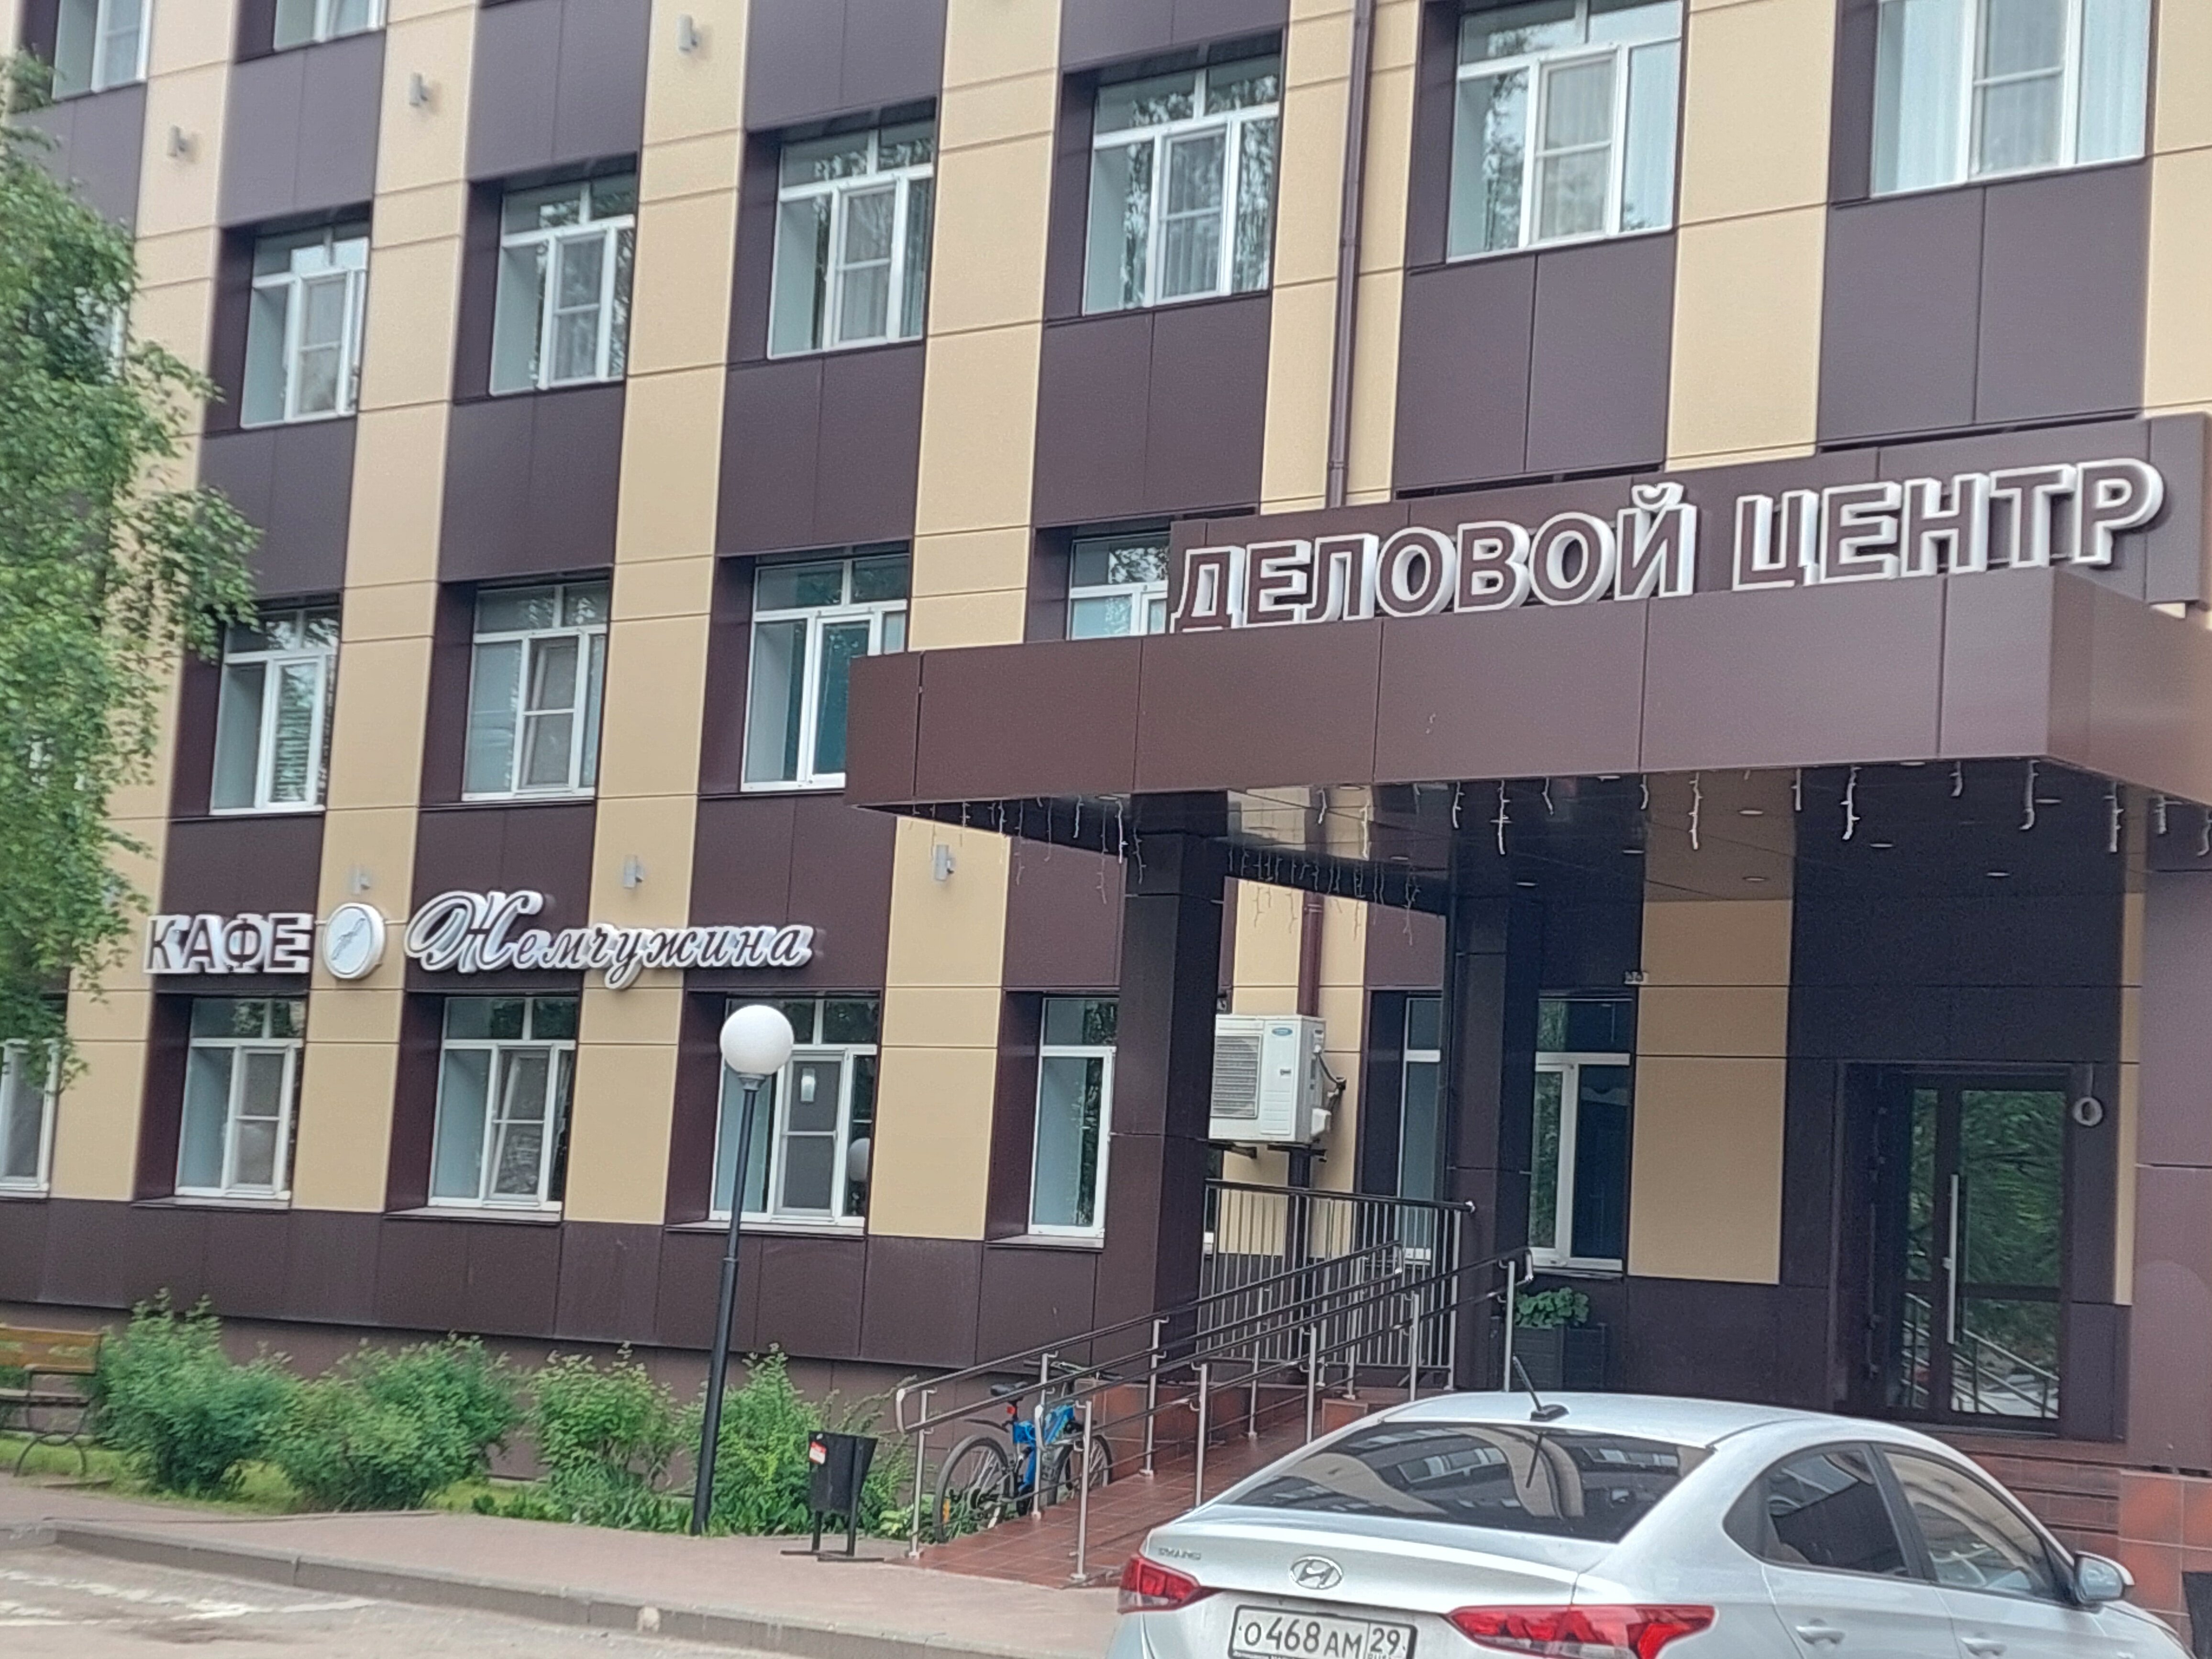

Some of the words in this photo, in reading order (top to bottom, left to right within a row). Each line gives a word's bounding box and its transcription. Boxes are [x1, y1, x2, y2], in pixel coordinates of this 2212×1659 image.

[1170, 482, 1697, 633] ДЕЛОВОЙ
[1732, 457, 2164, 591] ЦЕНТР
[144, 913, 314, 973] КАФЕ
[404, 890, 814, 989] Жемчужина
[1370, 1627, 1401, 1655] 29
